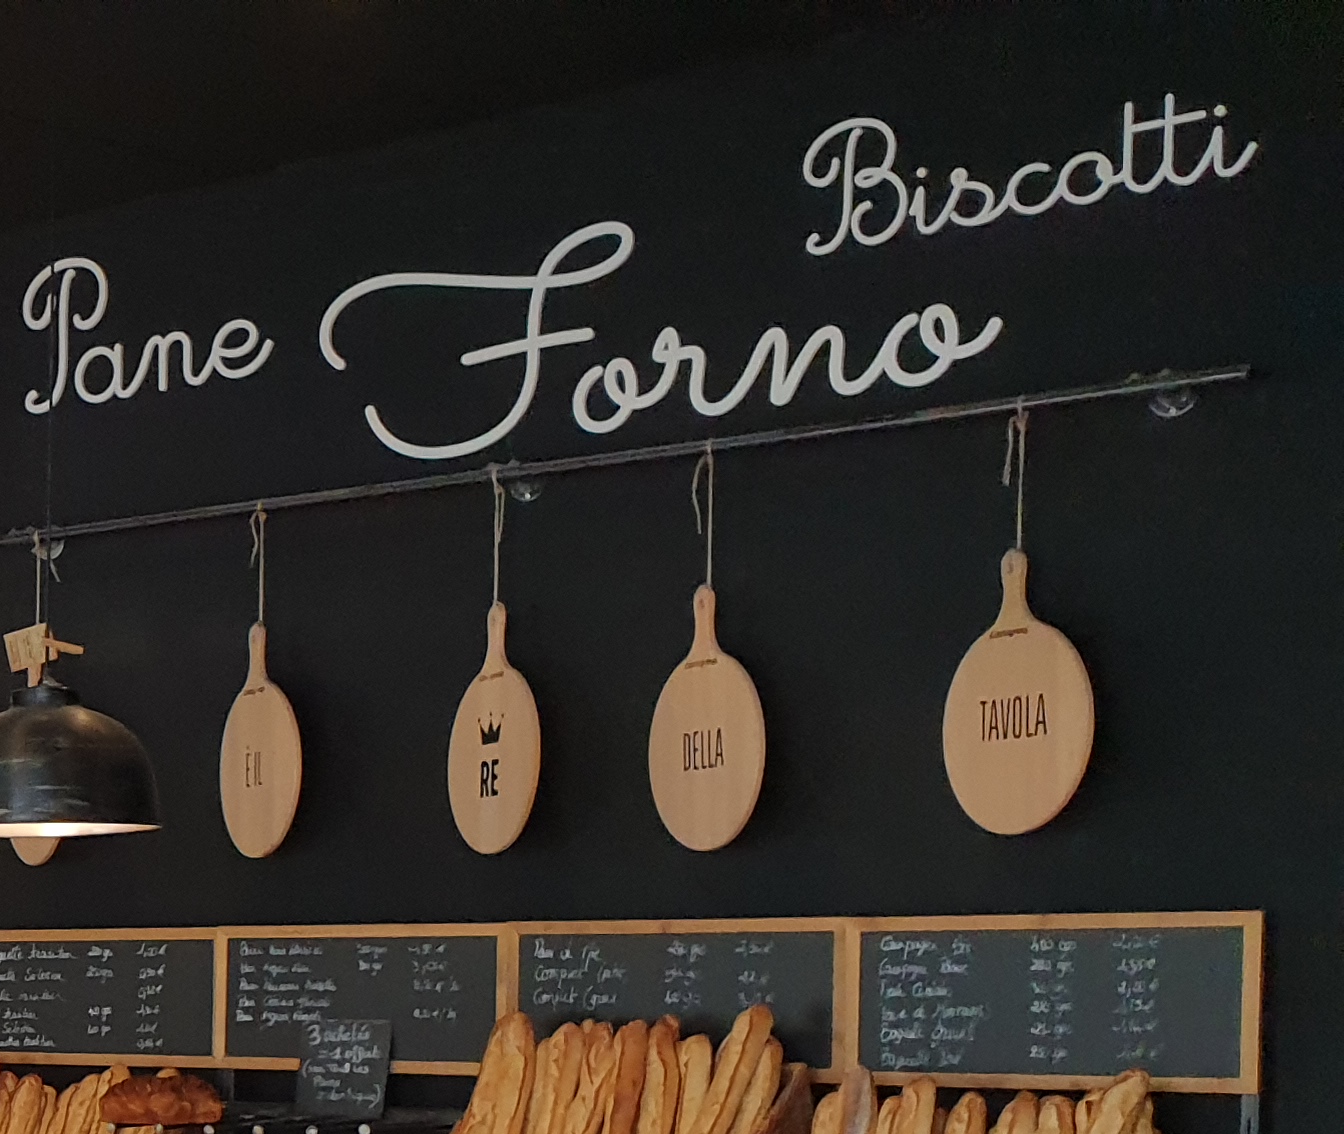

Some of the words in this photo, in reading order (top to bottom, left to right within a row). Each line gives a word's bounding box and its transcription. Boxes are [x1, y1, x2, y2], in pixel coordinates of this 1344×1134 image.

[802, 93, 1258, 256] Biscotti
[22, 257, 274, 414] Pane
[319, 221, 1003, 459] Forno
[682, 727, 724, 772] DELLA
[979, 693, 1049, 742] TAVOLA
[479, 759, 500, 799] RE
